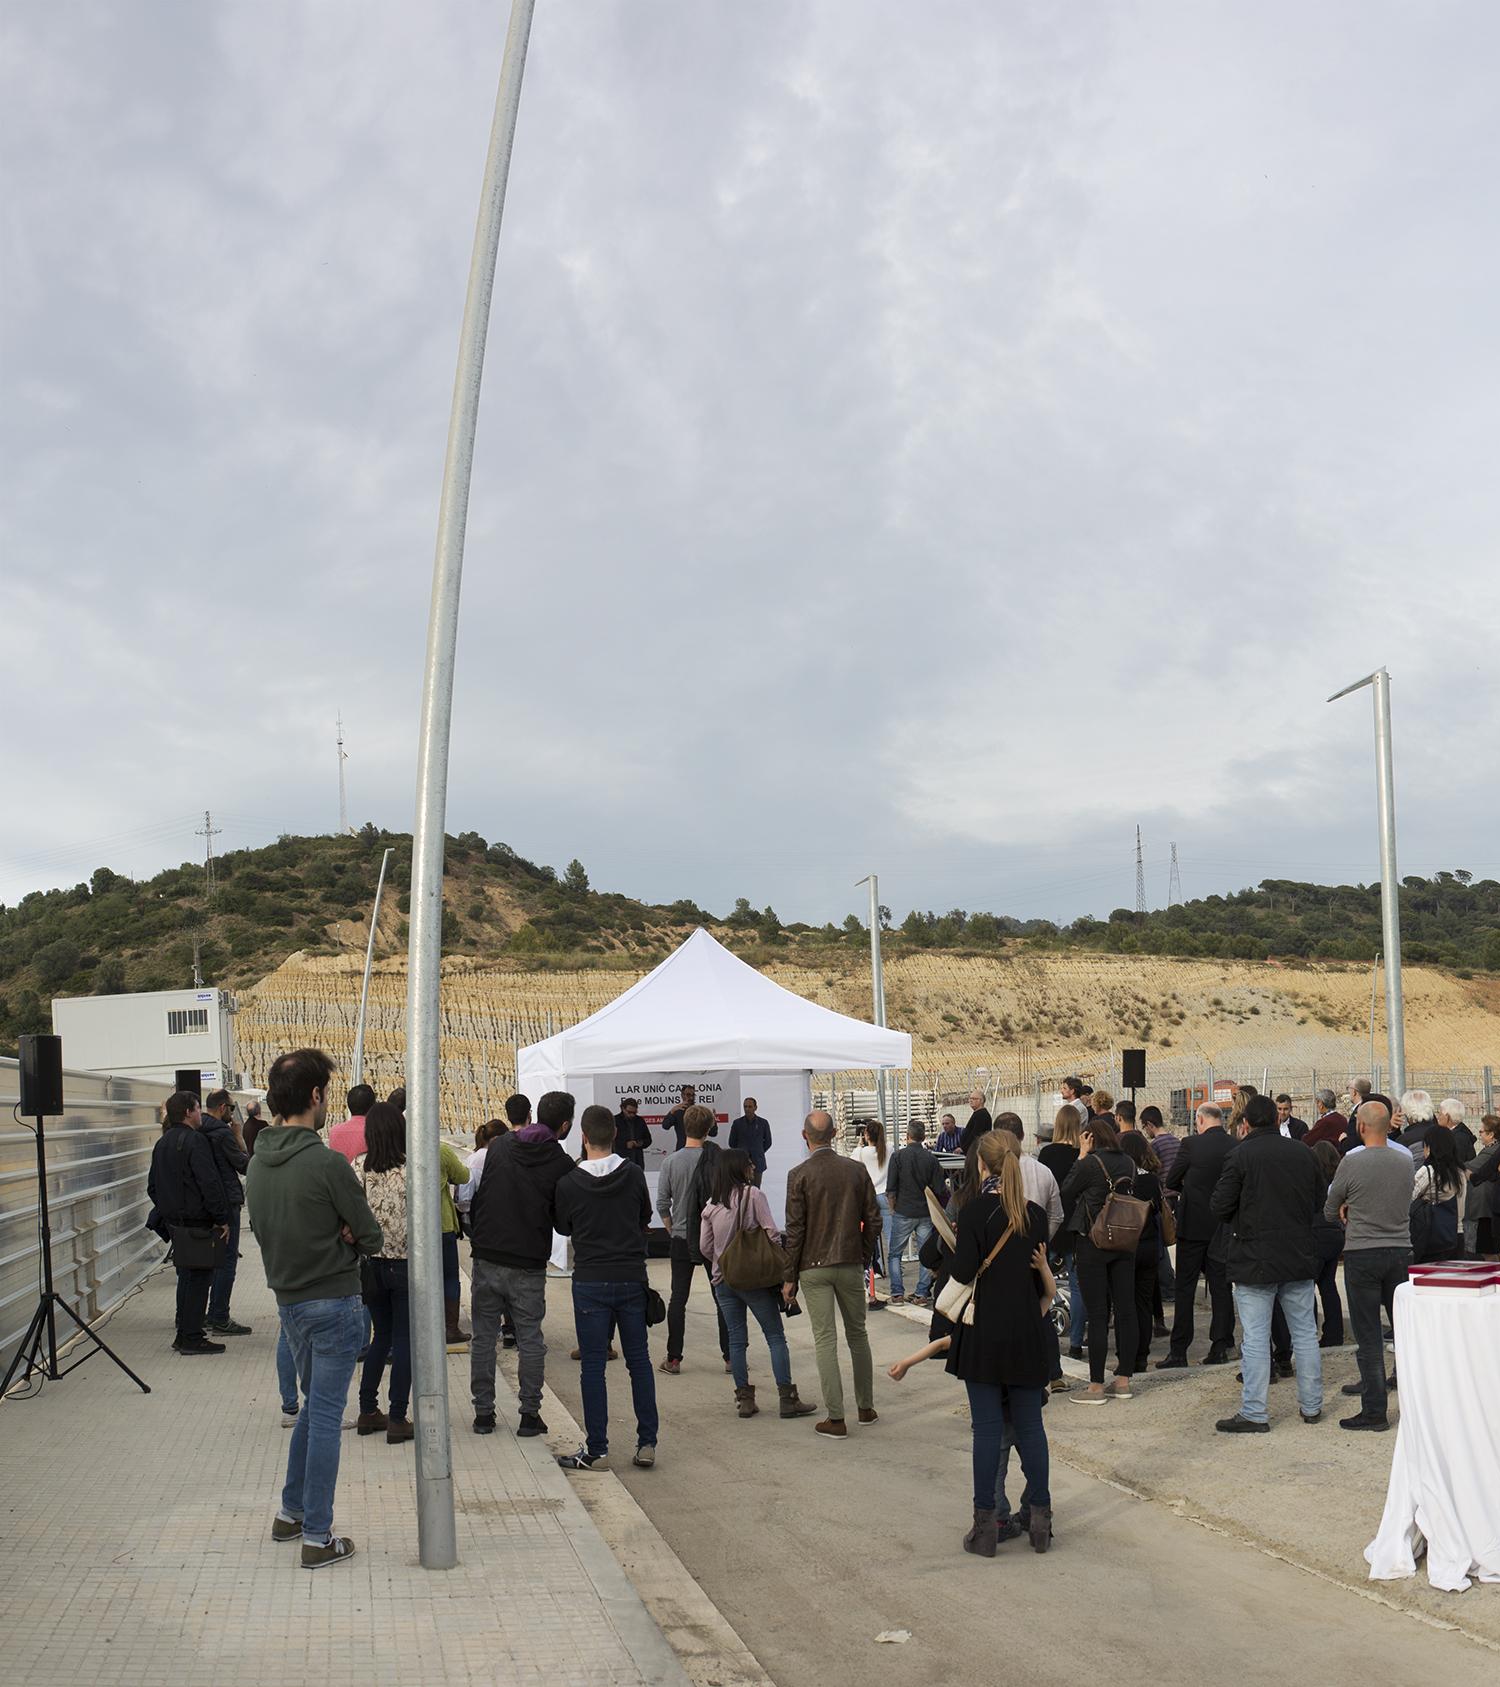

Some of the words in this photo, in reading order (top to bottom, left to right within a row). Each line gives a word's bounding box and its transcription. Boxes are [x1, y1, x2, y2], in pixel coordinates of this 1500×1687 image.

[615, 1085, 640, 1094] LLAR
[642, 1083, 666, 1093] UNIÓ
[668, 1083, 722, 1093] CATLONIA
[644, 1096, 681, 1105] MOLINS
[699, 1095, 714, 1103] REI
